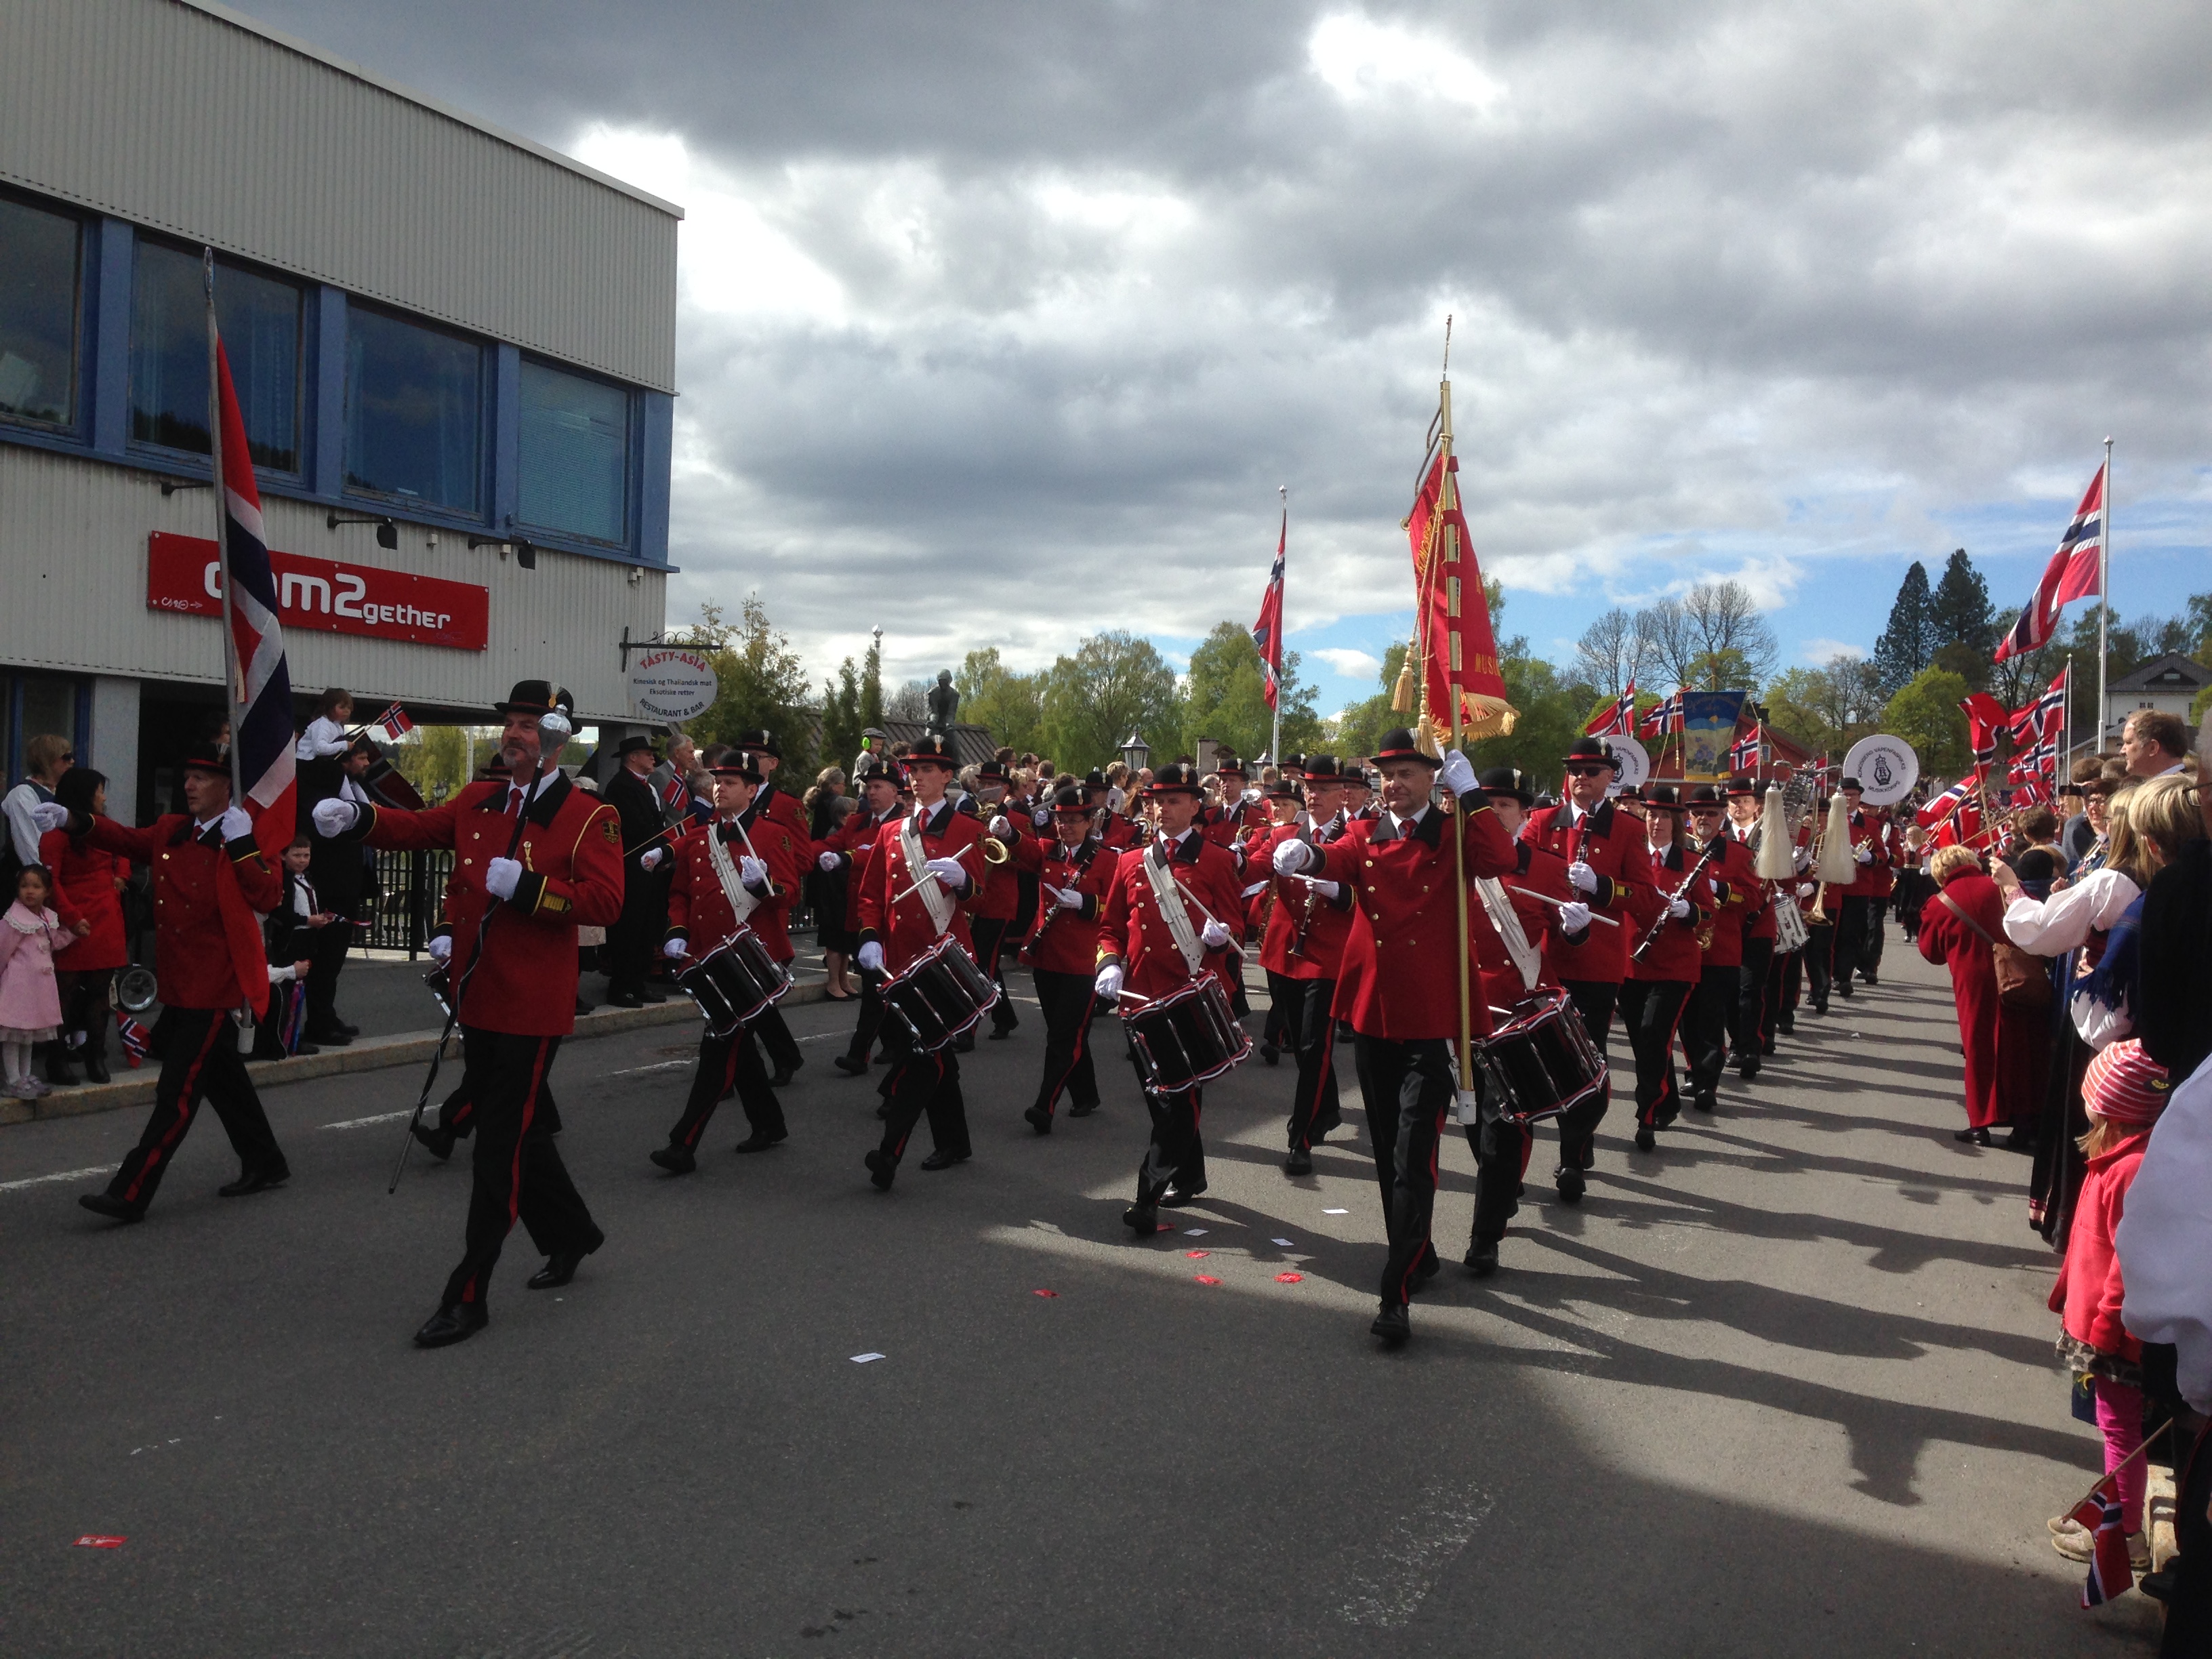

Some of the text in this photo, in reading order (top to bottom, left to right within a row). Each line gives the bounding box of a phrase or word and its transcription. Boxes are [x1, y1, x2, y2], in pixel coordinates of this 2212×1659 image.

[640, 651, 705, 672] TASTY-ASIA
[639, 698, 682, 717] RESTAURANT
[691, 701, 705, 714] BAR
